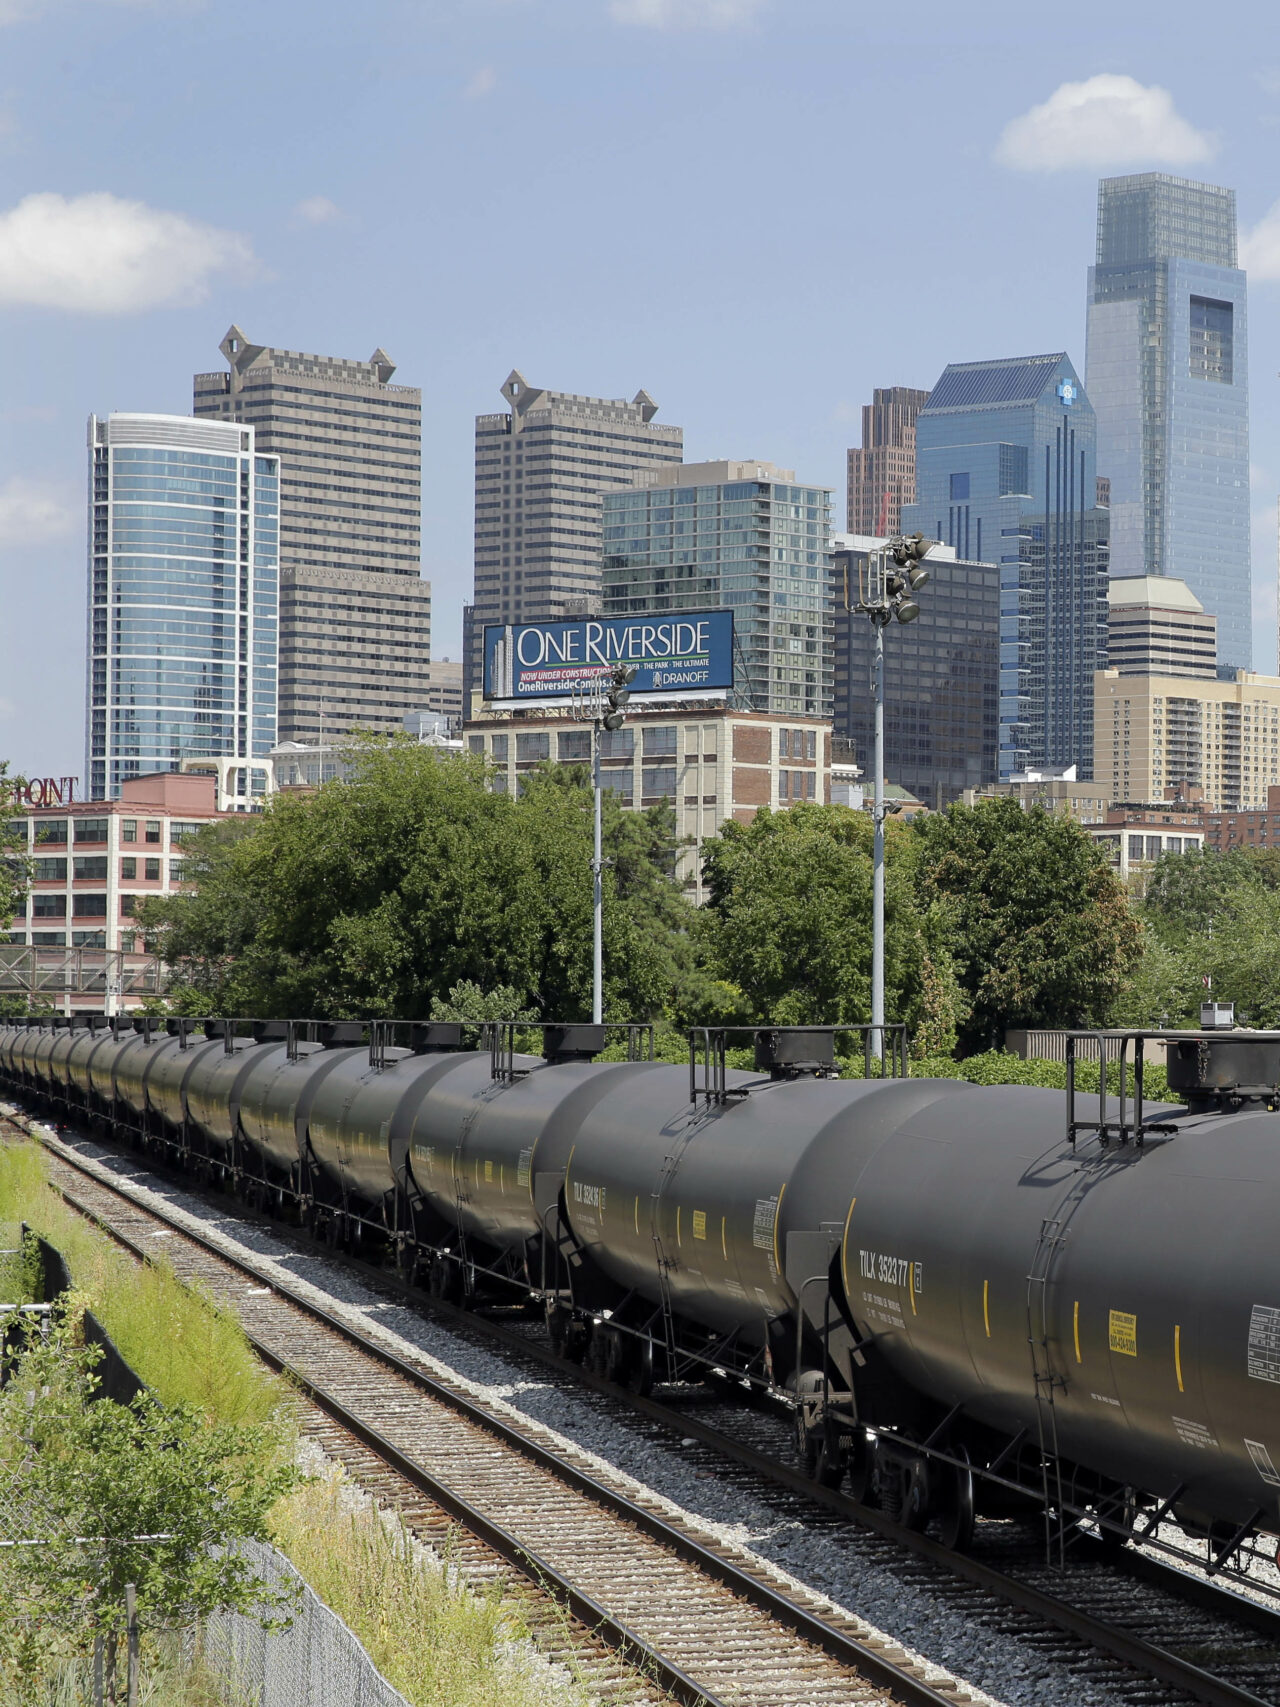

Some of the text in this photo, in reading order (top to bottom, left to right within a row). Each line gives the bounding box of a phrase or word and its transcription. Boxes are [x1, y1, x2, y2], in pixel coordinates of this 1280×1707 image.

[643, 662, 654, 670] THE
[655, 661, 669, 669] PARK
[672, 660, 682, 668] THE
[683, 658, 709, 668] ULTIMATE
[521, 673, 538, 681] NOW
[538, 671, 561, 680] UNDER
[663, 671, 709, 684] DRANOFF
[860, 1250, 908, 1288] TILX 352377
